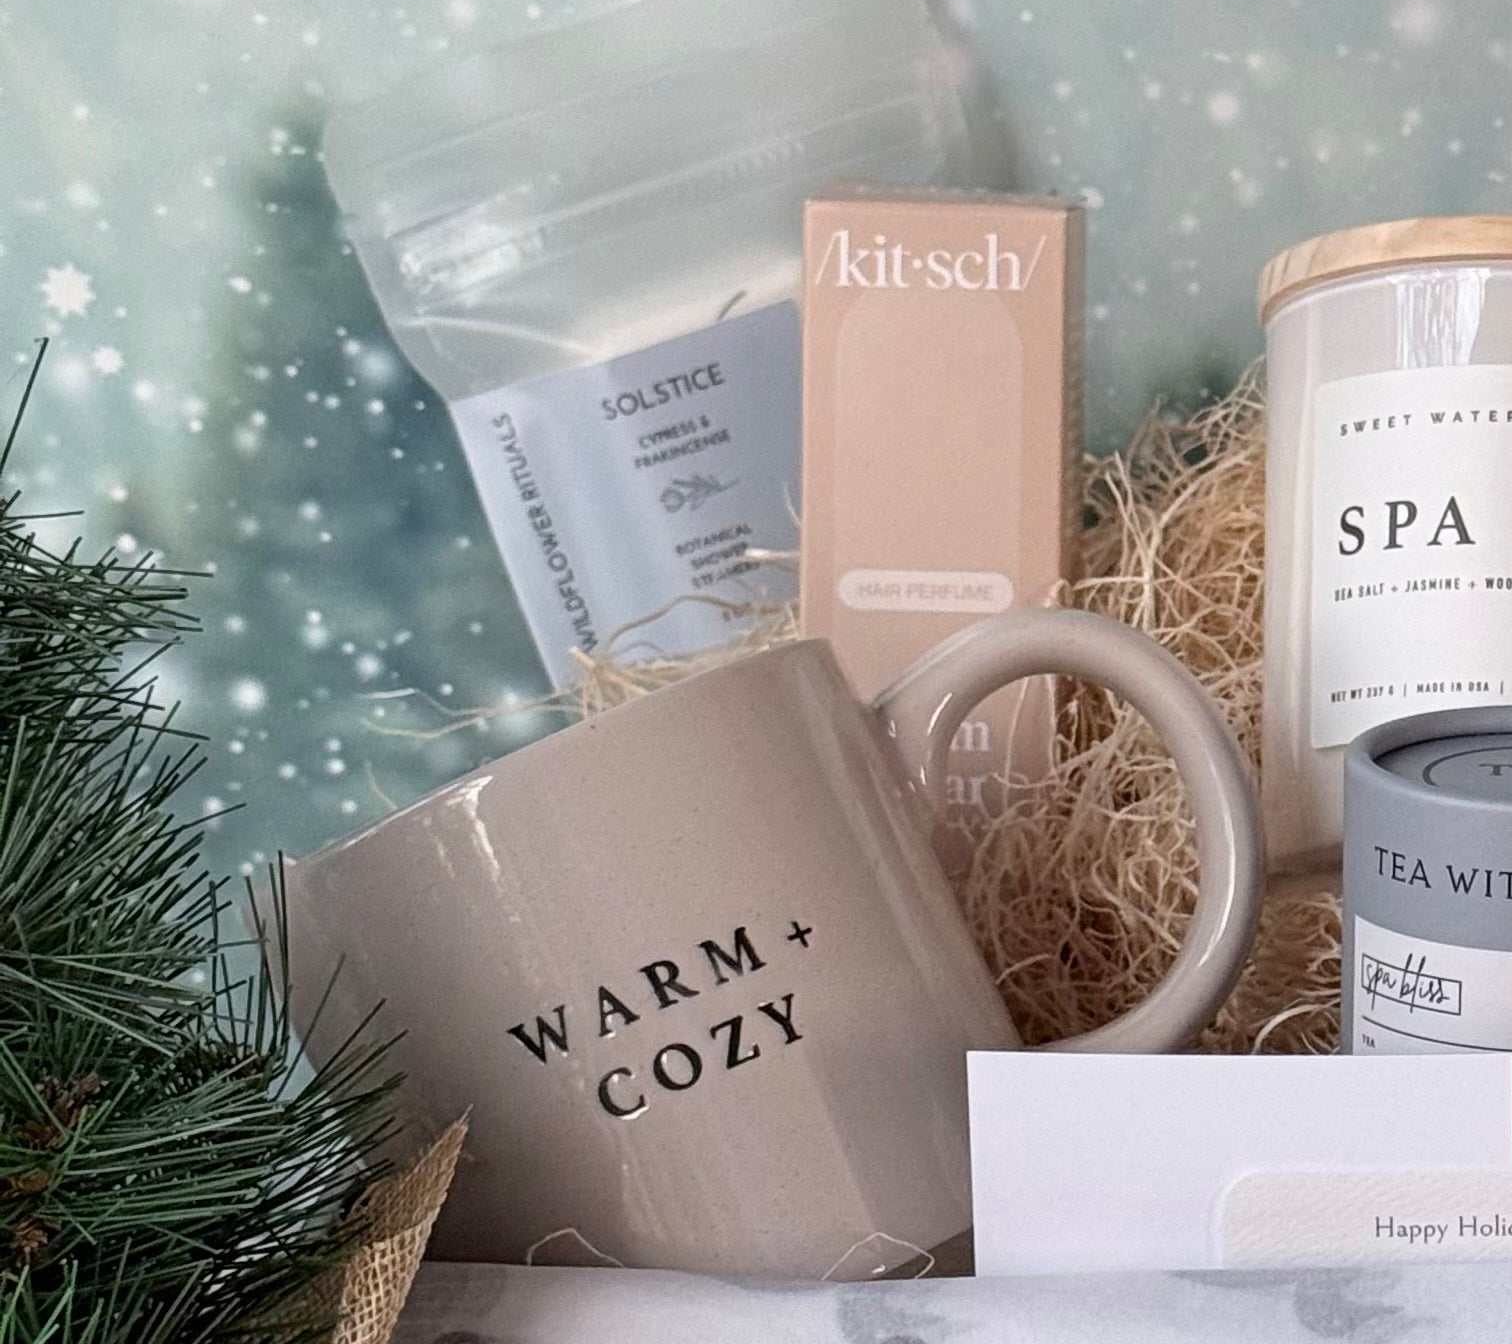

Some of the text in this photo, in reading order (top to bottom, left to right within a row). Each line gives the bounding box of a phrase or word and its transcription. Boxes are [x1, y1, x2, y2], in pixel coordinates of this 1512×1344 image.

[600, 361, 726, 421] SOLSTICE
[638, 419, 697, 449] CYPRESS
[1340, 414, 1412, 437] SWEET
[492, 412, 598, 653] WILDFLOWER RITUALS
[1338, 495, 1476, 556] SPA
[906, 582, 994, 600] PERFUME
[1334, 587, 1352, 602] SEA
[1358, 583, 1384, 598] SALT
[1405, 578, 1461, 593] JASMINE
[1331, 690, 1346, 703] NET
[1417, 682, 1445, 694] MADE
[1451, 682, 1462, 693] IN
[1469, 681, 1490, 693] USA
[1374, 845, 1431, 888] TEA
[505, 921, 813, 1065] WARM +
[1366, 952, 1451, 1013] spa bliss
[598, 993, 803, 1118] COZY
[1374, 1215, 1449, 1244] Happy
